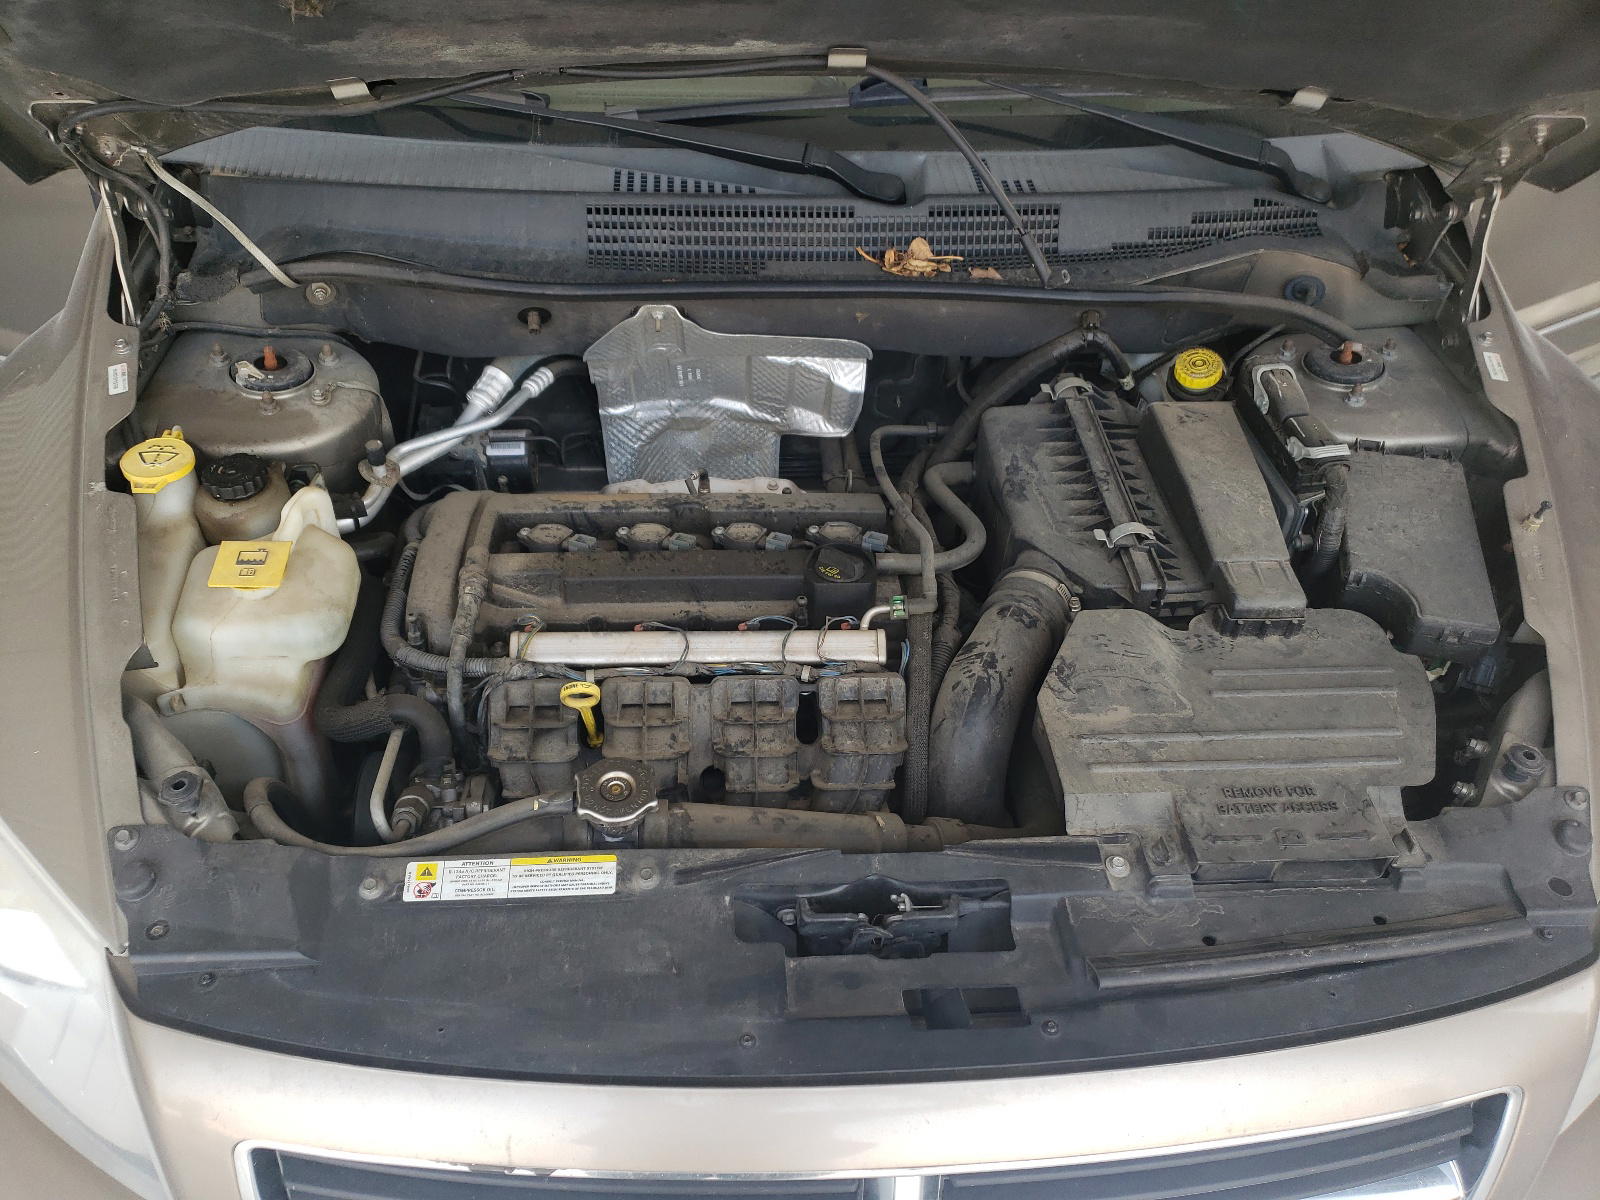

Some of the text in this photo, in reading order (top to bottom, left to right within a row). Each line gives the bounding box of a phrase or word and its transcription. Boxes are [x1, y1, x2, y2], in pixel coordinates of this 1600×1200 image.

[1222, 785, 1317, 799] REMOVE FOR
[1216, 800, 1339, 815] BATTERY ACCESS
